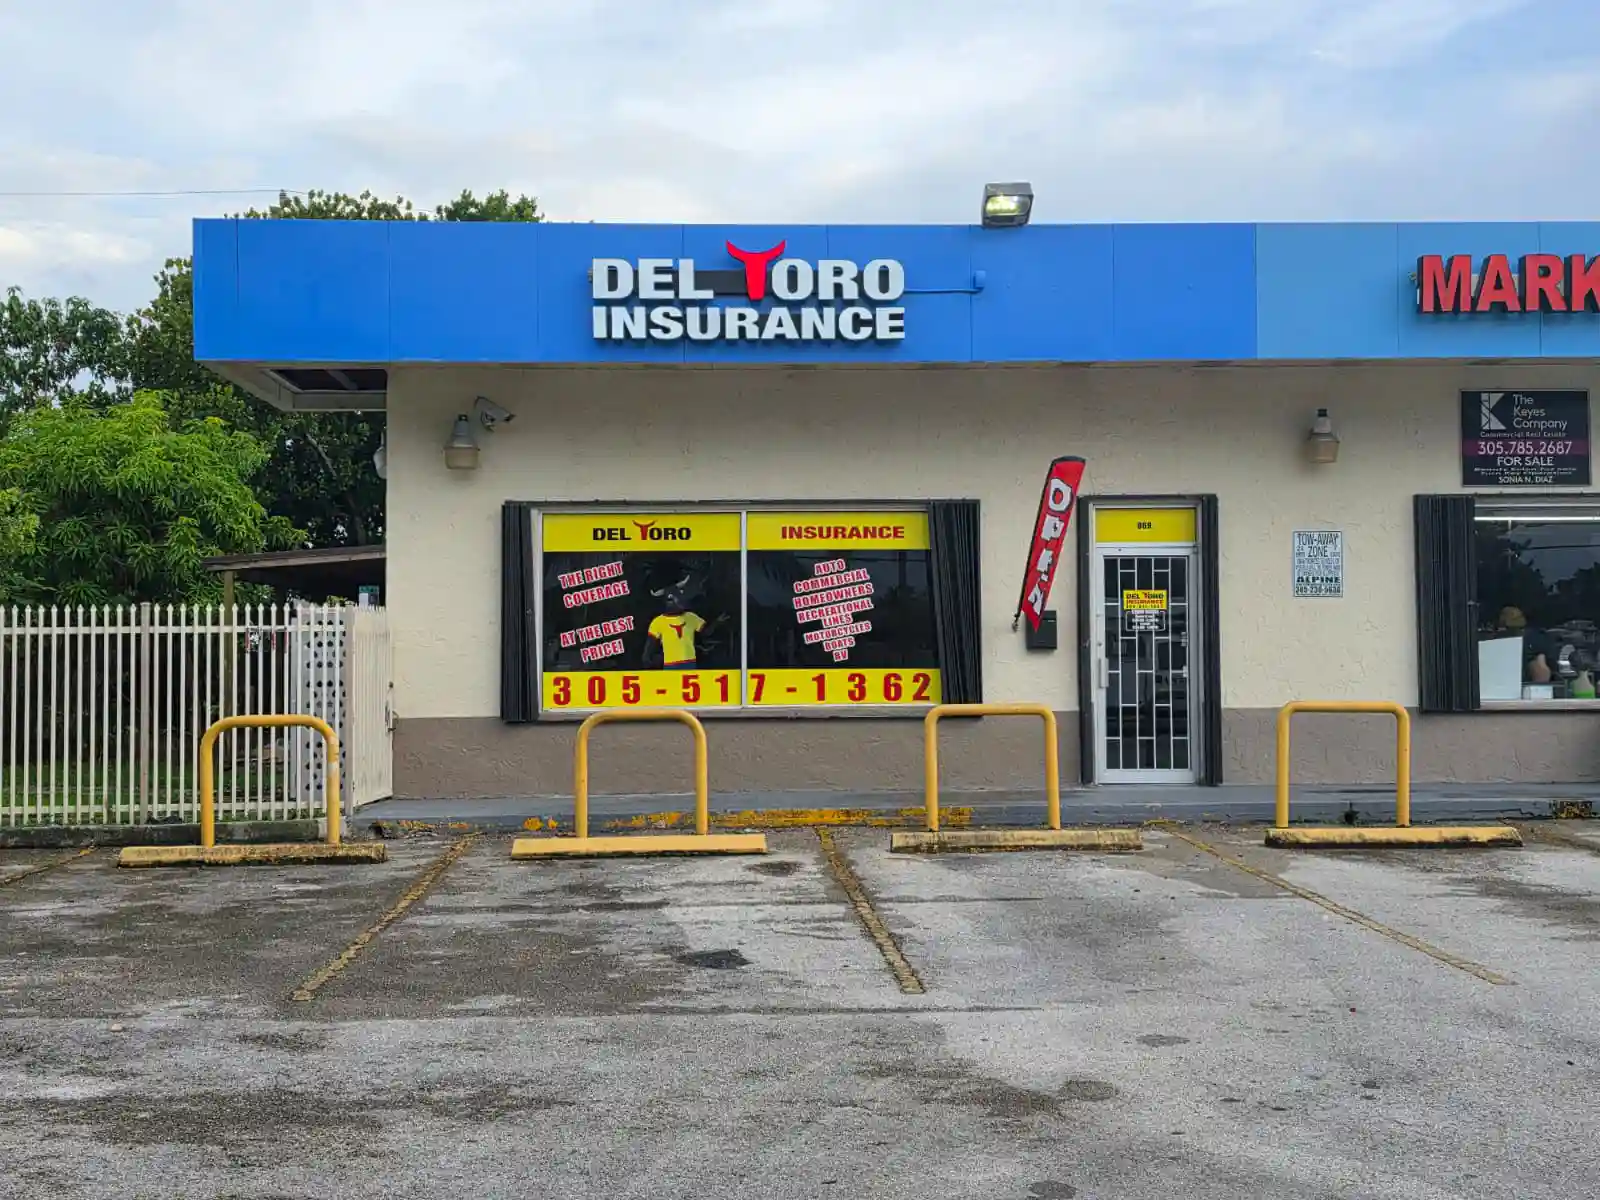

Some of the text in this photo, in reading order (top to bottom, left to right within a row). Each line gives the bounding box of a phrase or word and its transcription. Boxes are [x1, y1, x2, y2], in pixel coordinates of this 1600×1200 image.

[592, 239, 905, 301] DEL TORO
[1418, 254, 1600, 313] MARK
[592, 306, 906, 340] INSURANCE
[1513, 394, 1534, 405] The
[1513, 406, 1546, 419] Keyes
[1513, 417, 1568, 431] Company
[1477, 441, 1573, 455] 305.785.2687
[1496, 456, 1555, 466] FOR SALE
[1498, 476, 1523, 484] SONIA
[1535, 476, 1554, 484] DIAZ
[592, 519, 692, 541] DEL TORO
[781, 525, 905, 540] INSURANCE
[1297, 533, 1339, 546] TOW-AWAY
[1307, 545, 1328, 558] ZONE
[559, 562, 623, 589] THE RIGHT
[814, 559, 846, 575] AUTO
[793, 568, 870, 594] COMMERCIAL
[563, 580, 630, 608] COVERAGE
[793, 583, 874, 609] HOMEOWNERS
[797, 598, 874, 623] RECREATIONAL
[822, 613, 853, 628] LINES
[560, 616, 634, 648] AT THE BEST
[804, 621, 872, 644] MOTORCYCLES
[581, 638, 625, 664] PRICE!
[823, 636, 855, 652] BOATS
